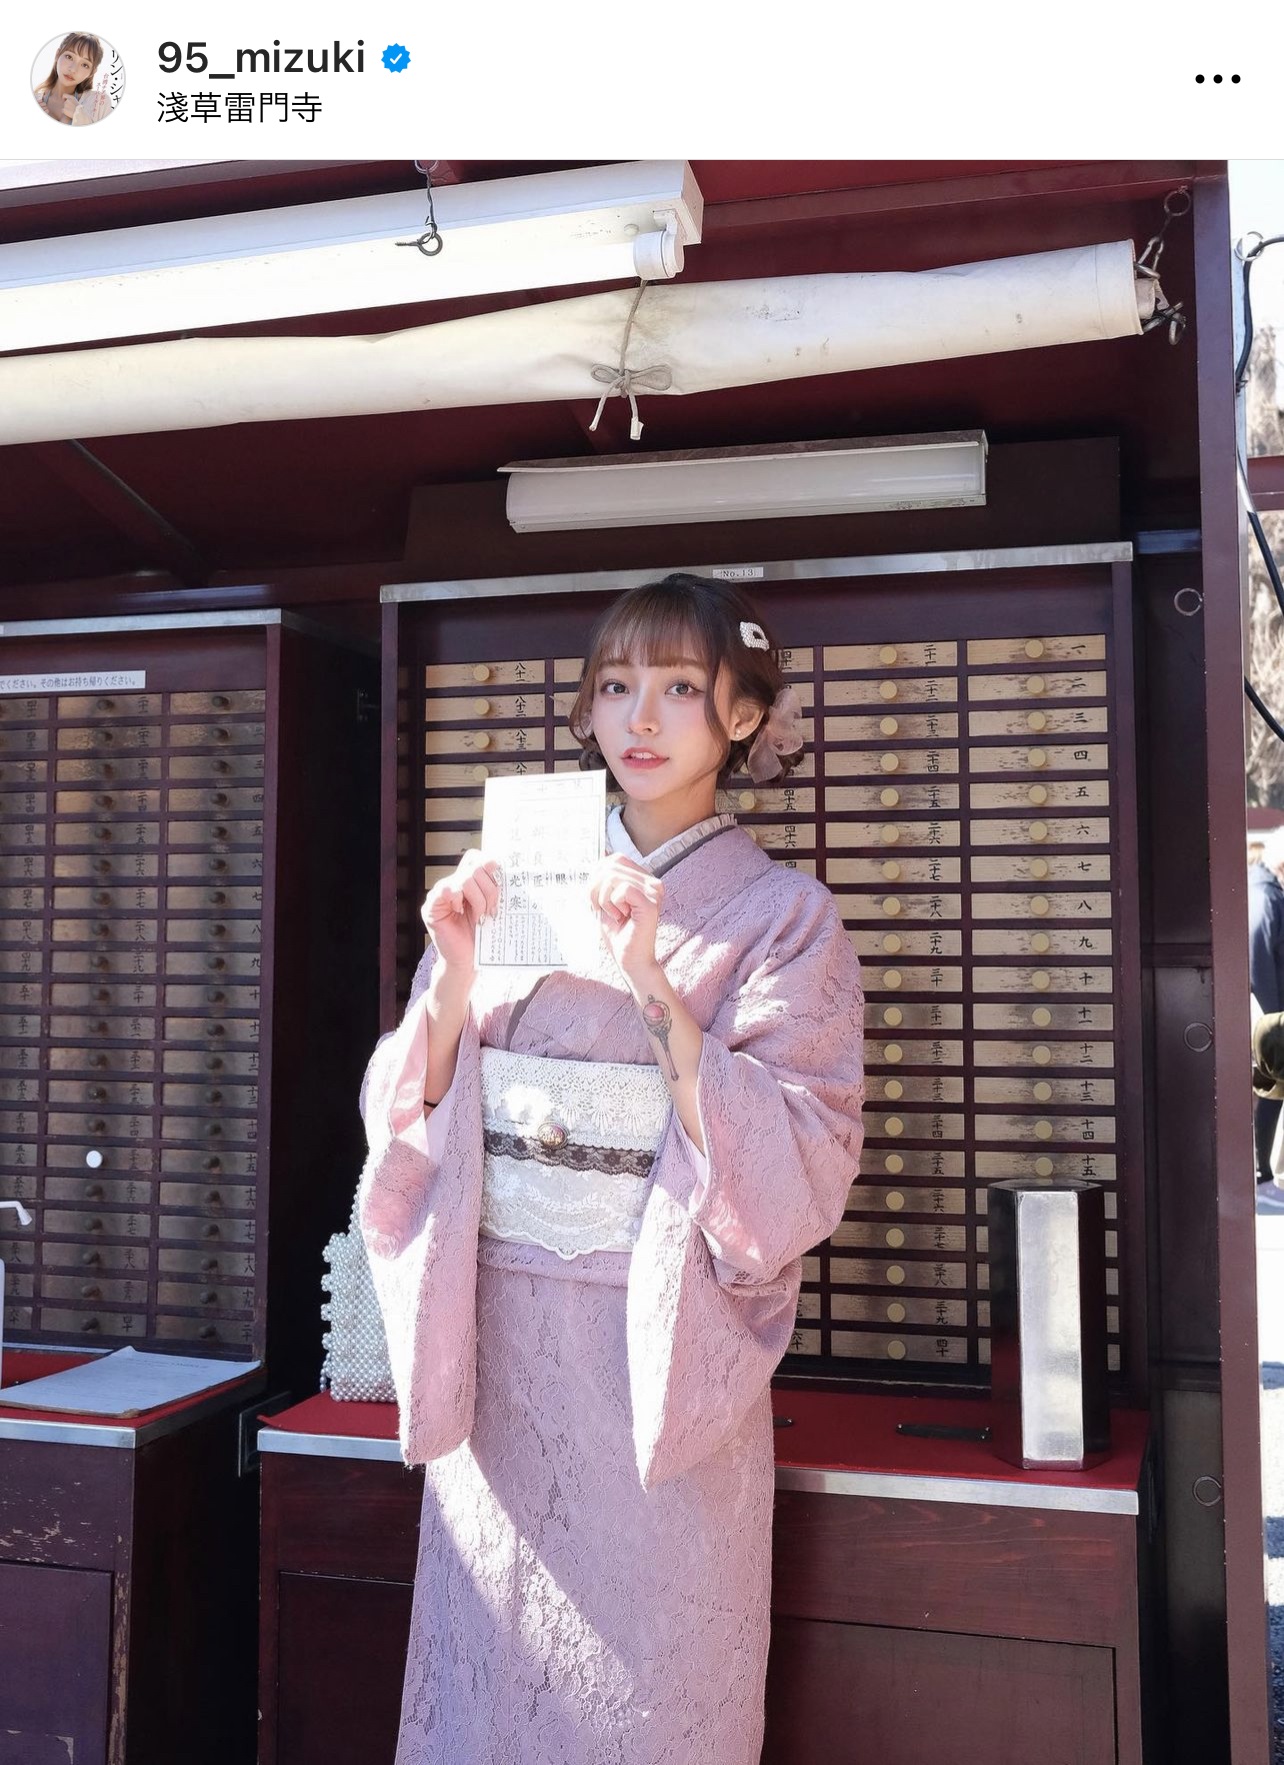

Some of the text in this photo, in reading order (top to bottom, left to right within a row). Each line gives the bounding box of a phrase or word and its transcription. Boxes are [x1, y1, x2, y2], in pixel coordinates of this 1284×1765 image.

[781, 650, 792, 670] 四十一
[924, 644, 936, 665] 二十一
[515, 662, 526, 682] 八十一
[1072, 677, 1086, 688] 二
[925, 680, 938, 701] 二十二
[515, 695, 527, 717] 八十二
[1073, 712, 1088, 723] 三
[515, 729, 527, 750] 八十三
[926, 751, 939, 772] 二十四
[1074, 750, 1088, 760] 四
[516, 762, 527, 776] 八十
[783, 789, 796, 811] 四十五
[927, 786, 940, 808] 二十五
[1075, 786, 1089, 798] 五
[784, 825, 797, 848] 四十六
[928, 822, 941, 844] 二十六
[1076, 824, 1090, 835] 六
[928, 859, 941, 881] 二十七
[1077, 861, 1092, 871] 七
[929, 895, 942, 918] 二十八
[1077, 900, 1092, 911] 八
[929, 932, 942, 954] 二十九
[1079, 936, 1093, 948] 九
[930, 968, 943, 987] 三十
[1079, 972, 1093, 985] 十
[930, 1005, 942, 1026] 三十一
[1078, 1006, 1093, 1024] 十一
[931, 1041, 943, 1064] 三十二
[1079, 1043, 1093, 1063] 十二
[932, 1078, 943, 1101] 三十三
[1080, 1080, 1094, 1101] 十三
[931, 1114, 943, 1138] 三十四
[1081, 1118, 1095, 1140] 十四
[931, 1152, 944, 1175] 三十五
[1081, 1154, 1096, 1176] 十五
[932, 1189, 945, 1213] 三十六
[933, 1226, 946, 1249] 三十七
[934, 1264, 947, 1286] 三十八
[935, 1301, 948, 1325] 三十九
[936, 1339, 948, 1357] 四十
